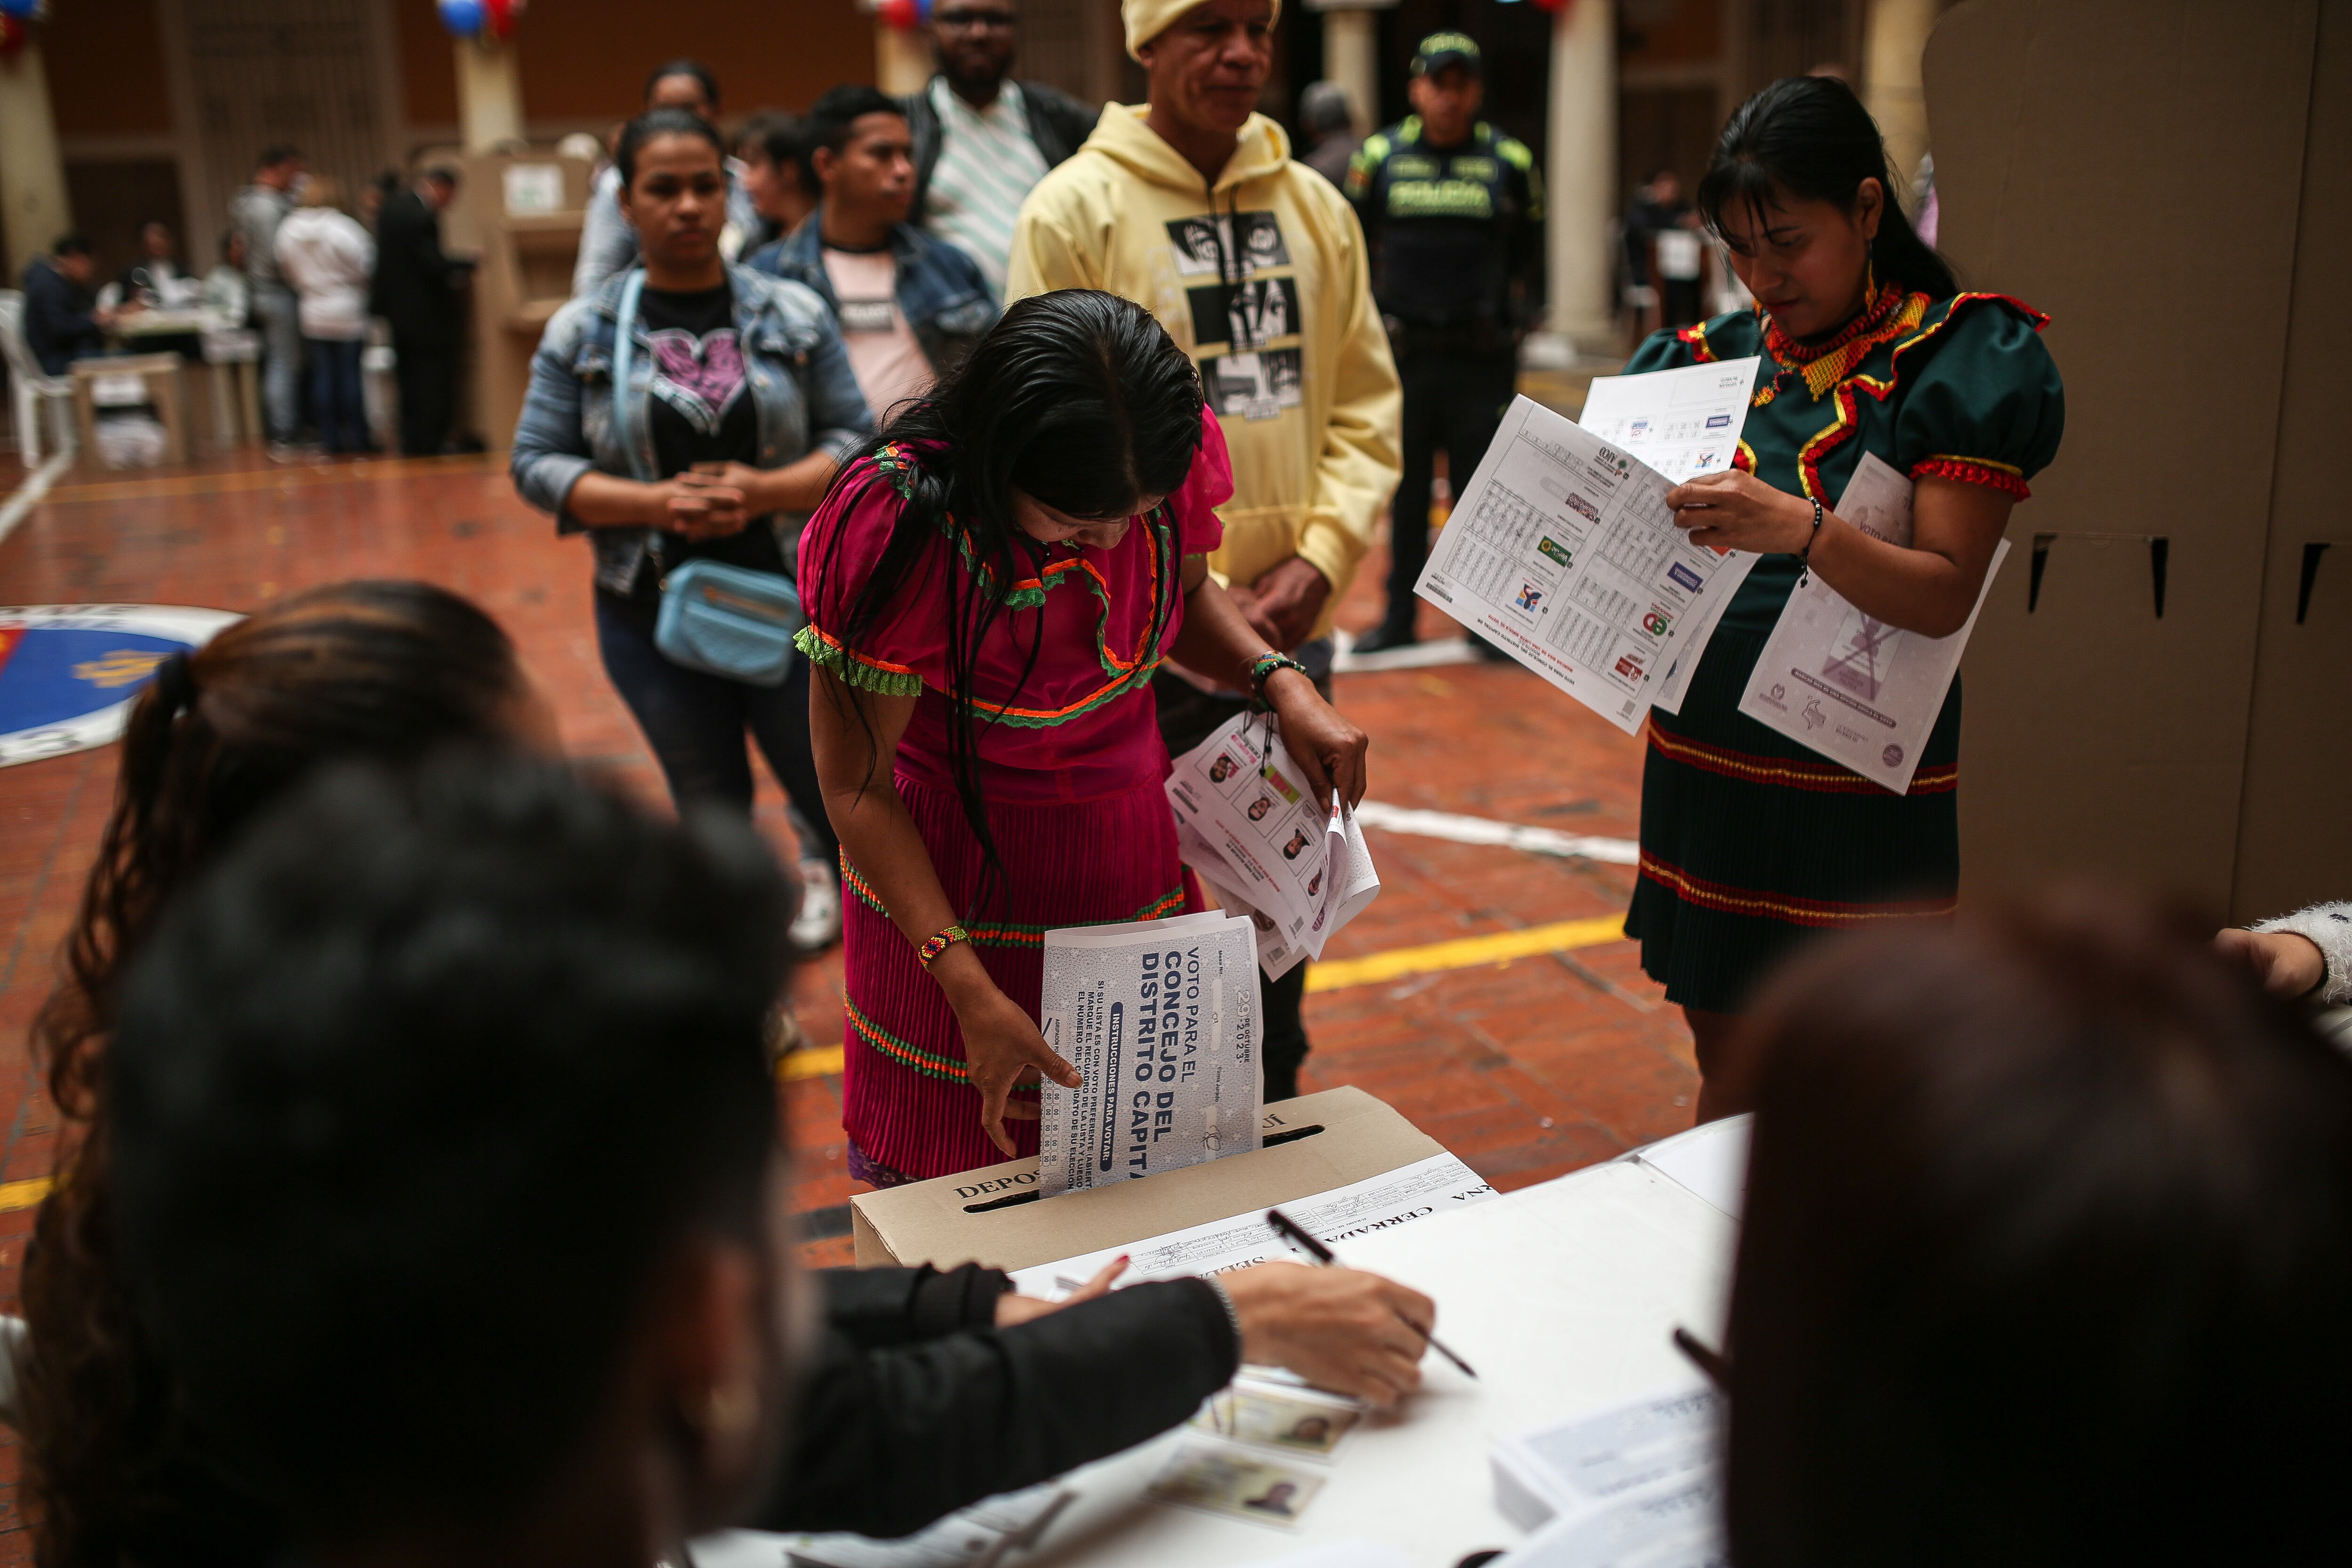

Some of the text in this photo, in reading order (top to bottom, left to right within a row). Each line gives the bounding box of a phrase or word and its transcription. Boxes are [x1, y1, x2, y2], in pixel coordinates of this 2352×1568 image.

[1078, 991, 1085, 1002] EL
[1097, 980, 1104, 989] SI
[1097, 992, 1104, 1004] SU
[1086, 992, 1094, 1029] MARQUE
[1135, 952, 1159, 1082] DISTRITO
[1181, 947, 1199, 1083] VOTO PARA EL
[1237, 990, 1251, 1018] 29
[1075, 1005, 1086, 1043] NÚMERO
[1085, 1032, 1092, 1043] EL
[1094, 1035, 1102, 1045] ES
[1153, 951, 1182, 1143] CONCEJO DEL
[1082, 1045, 1092, 1093] RECUADRO
[1092, 1048, 1101, 1067] CON
[1071, 1066, 1081, 1116] CIDATO
[1102, 1013, 1120, 1161] INSTRUCCIONES PARA VOTAR:
[1081, 1097, 1089, 1108] DE
[1081, 1110, 1088, 1121] LA
[1071, 1119, 1078, 1130] DE
[1087, 1096, 1097, 1151] PREFERENTE
[1263, 1114, 1287, 1128] UÍ
[1070, 1133, 1078, 1144] SU
[1078, 1123, 1087, 1148] LISTA
[1067, 1147, 1076, 1190] ELECCIÓN
[1076, 1158, 1084, 1188] LUEGO
[1084, 1154, 1093, 1190] (ABIERT
[1323, 1207, 1433, 1243] CERRADA
[1344, 1217, 1367, 1227] JURADO
